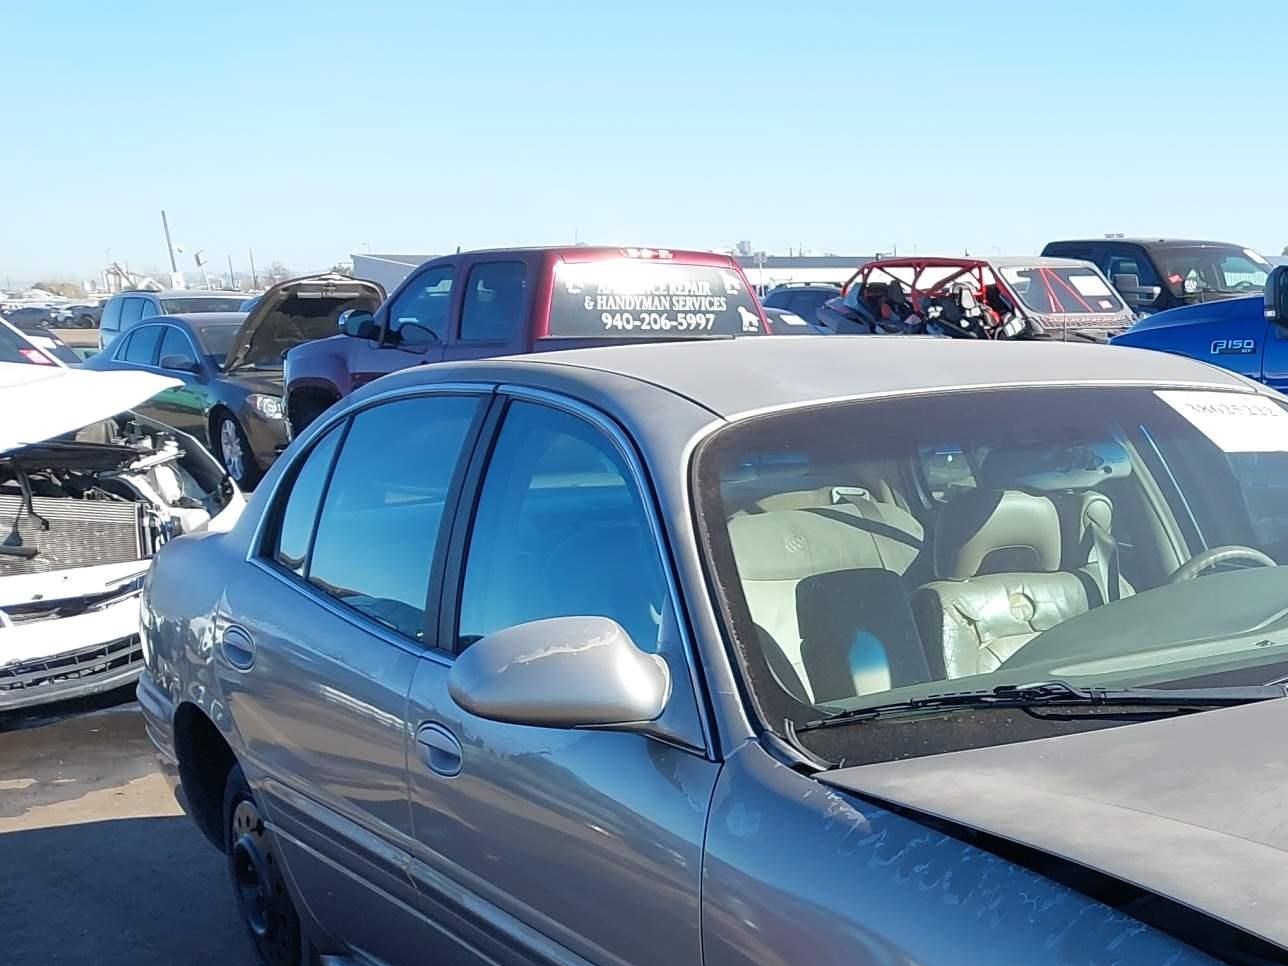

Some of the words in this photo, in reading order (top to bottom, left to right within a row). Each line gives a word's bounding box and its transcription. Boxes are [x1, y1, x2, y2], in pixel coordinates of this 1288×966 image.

[668, 281, 712, 295] REPAIR
[584, 295, 595, 310] &
[597, 296, 670, 311] HANDYMAN
[672, 297, 727, 311] SERVICES
[601, 312, 716, 331] 940-206-5997
